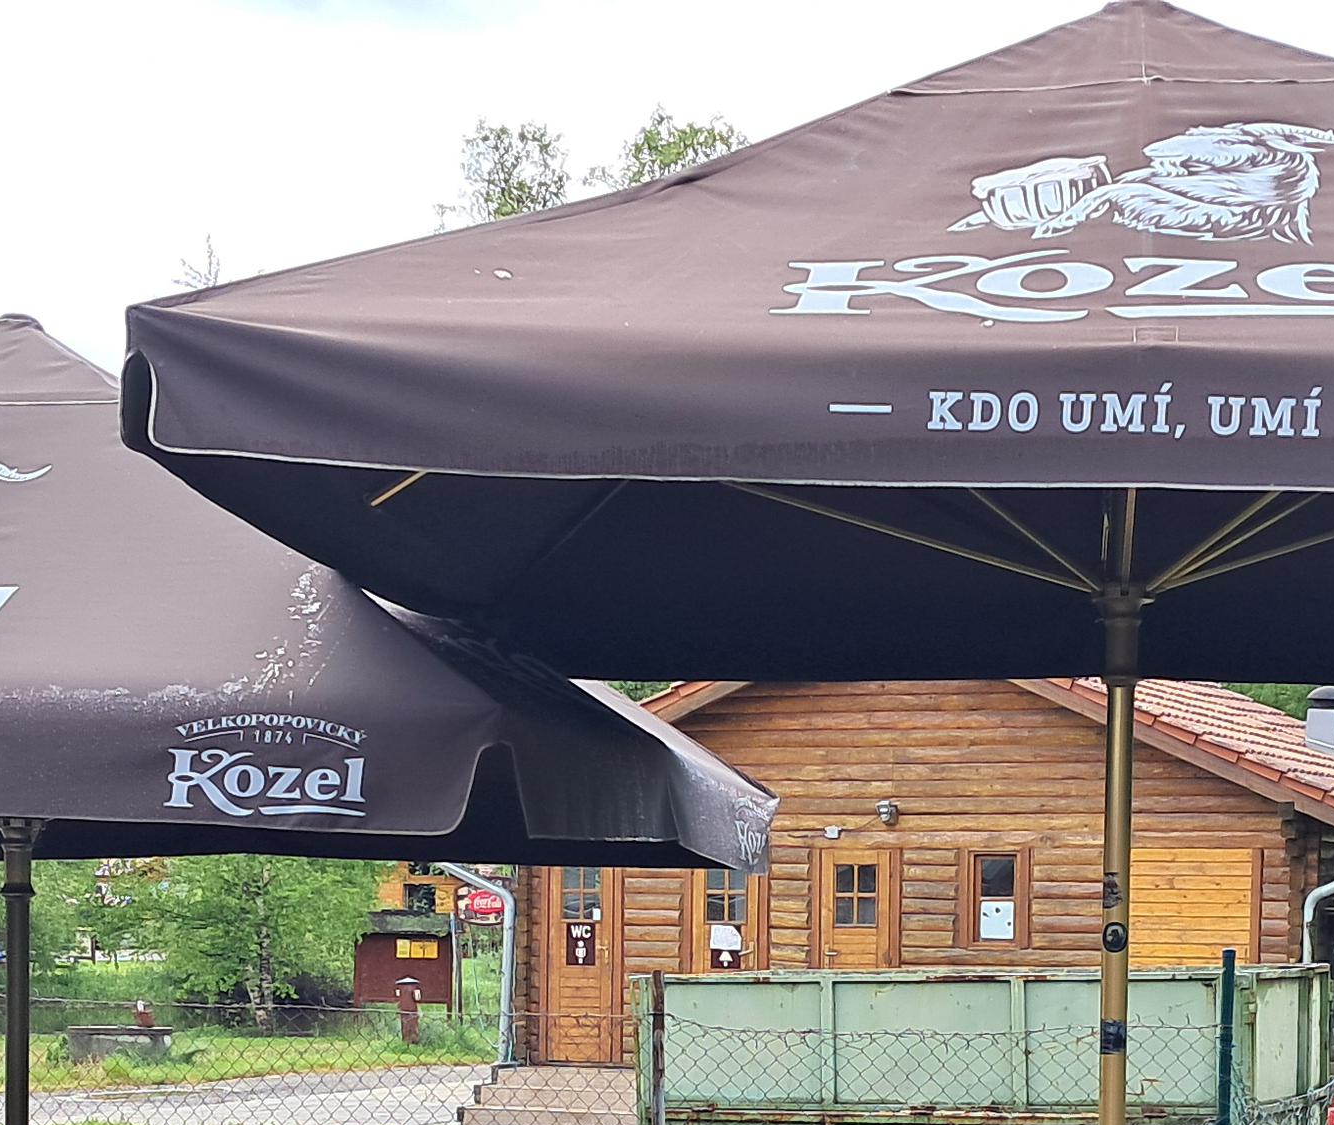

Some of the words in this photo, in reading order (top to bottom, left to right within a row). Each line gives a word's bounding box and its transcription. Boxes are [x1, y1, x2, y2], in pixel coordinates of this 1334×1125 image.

[927, 390, 1039, 433] KDO
[1060, 383, 1186, 440] UMÍ,
[1207, 387, 1323, 437] UMÍ
[175, 713, 367, 745] VELKOPOPOVICKÝ
[253, 729, 293, 745] 1874
[163, 748, 366, 817] Kozel
[570, 925, 592, 939] WC
